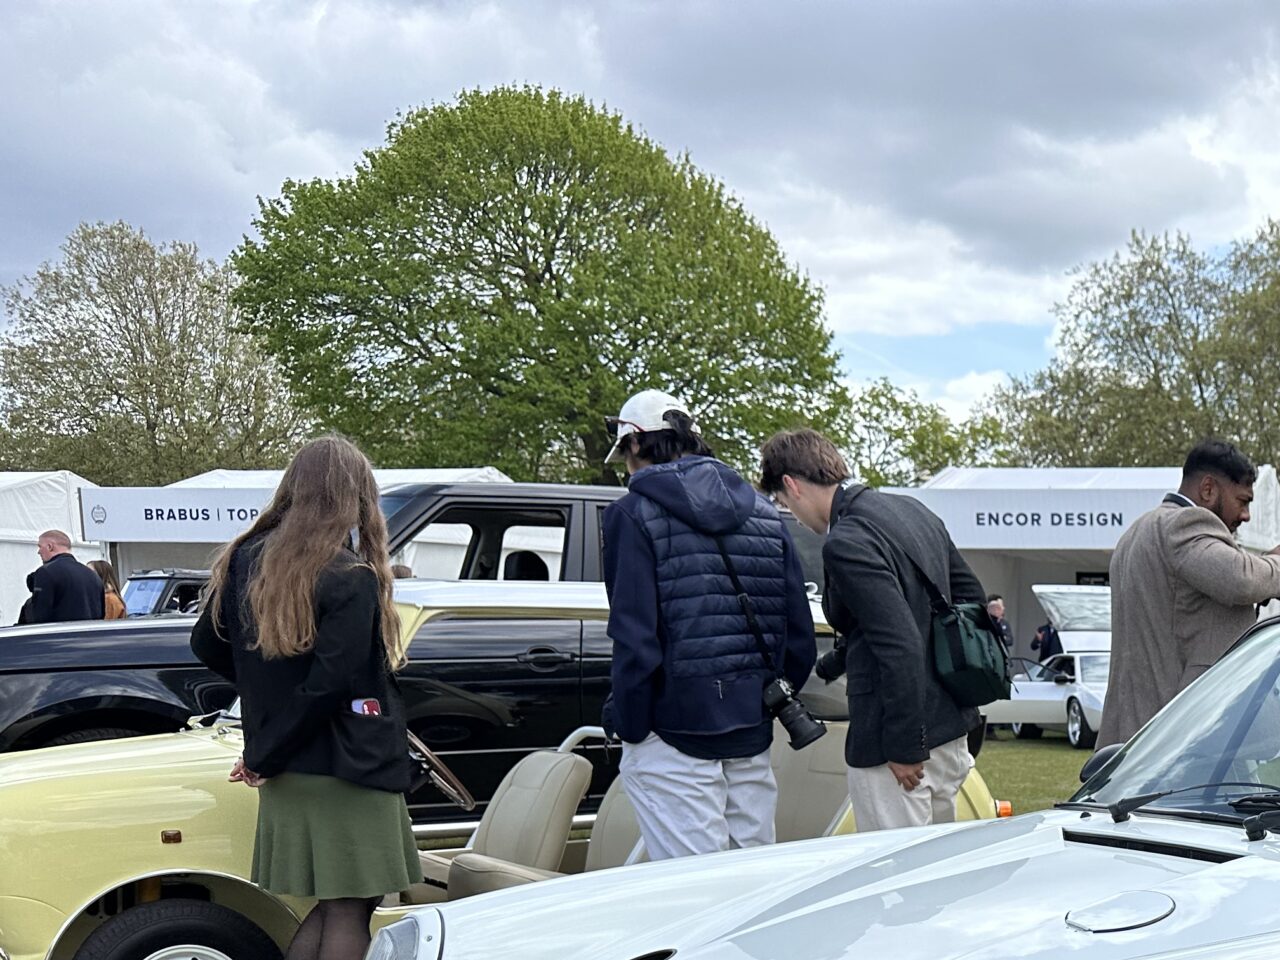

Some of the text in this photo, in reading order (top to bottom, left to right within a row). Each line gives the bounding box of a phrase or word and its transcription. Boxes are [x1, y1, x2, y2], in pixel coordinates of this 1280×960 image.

[143, 507, 210, 521] BRABUS
[975, 512, 1124, 527] ENCOR DESIGN
